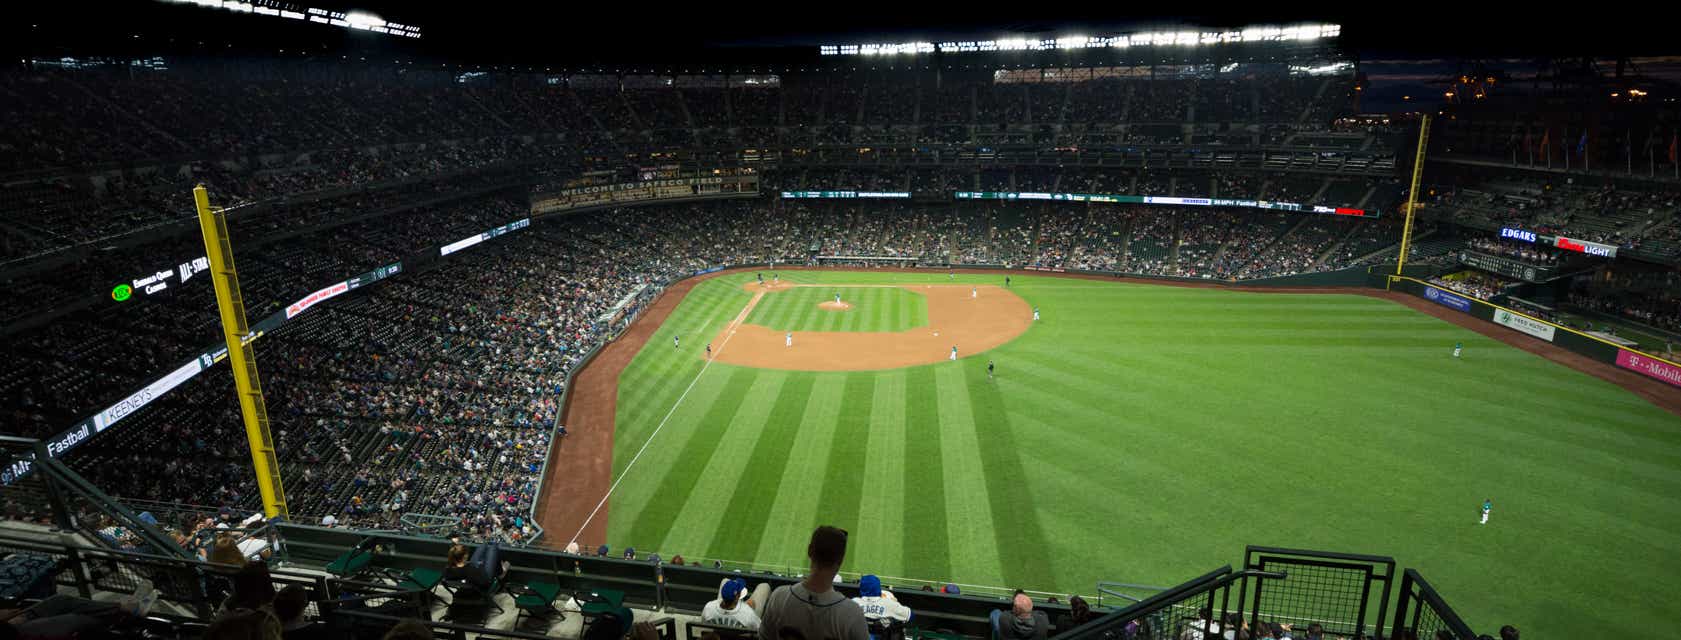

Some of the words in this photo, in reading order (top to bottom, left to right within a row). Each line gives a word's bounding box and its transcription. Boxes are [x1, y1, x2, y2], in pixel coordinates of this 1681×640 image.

[561, 184, 615, 197] WELCOME
[620, 182, 634, 190] TO
[639, 179, 684, 188] SAFECO
[690, 177, 723, 185] FIELD
[1584, 245, 1610, 257] LIGHT
[47, 423, 90, 457] Fastball
